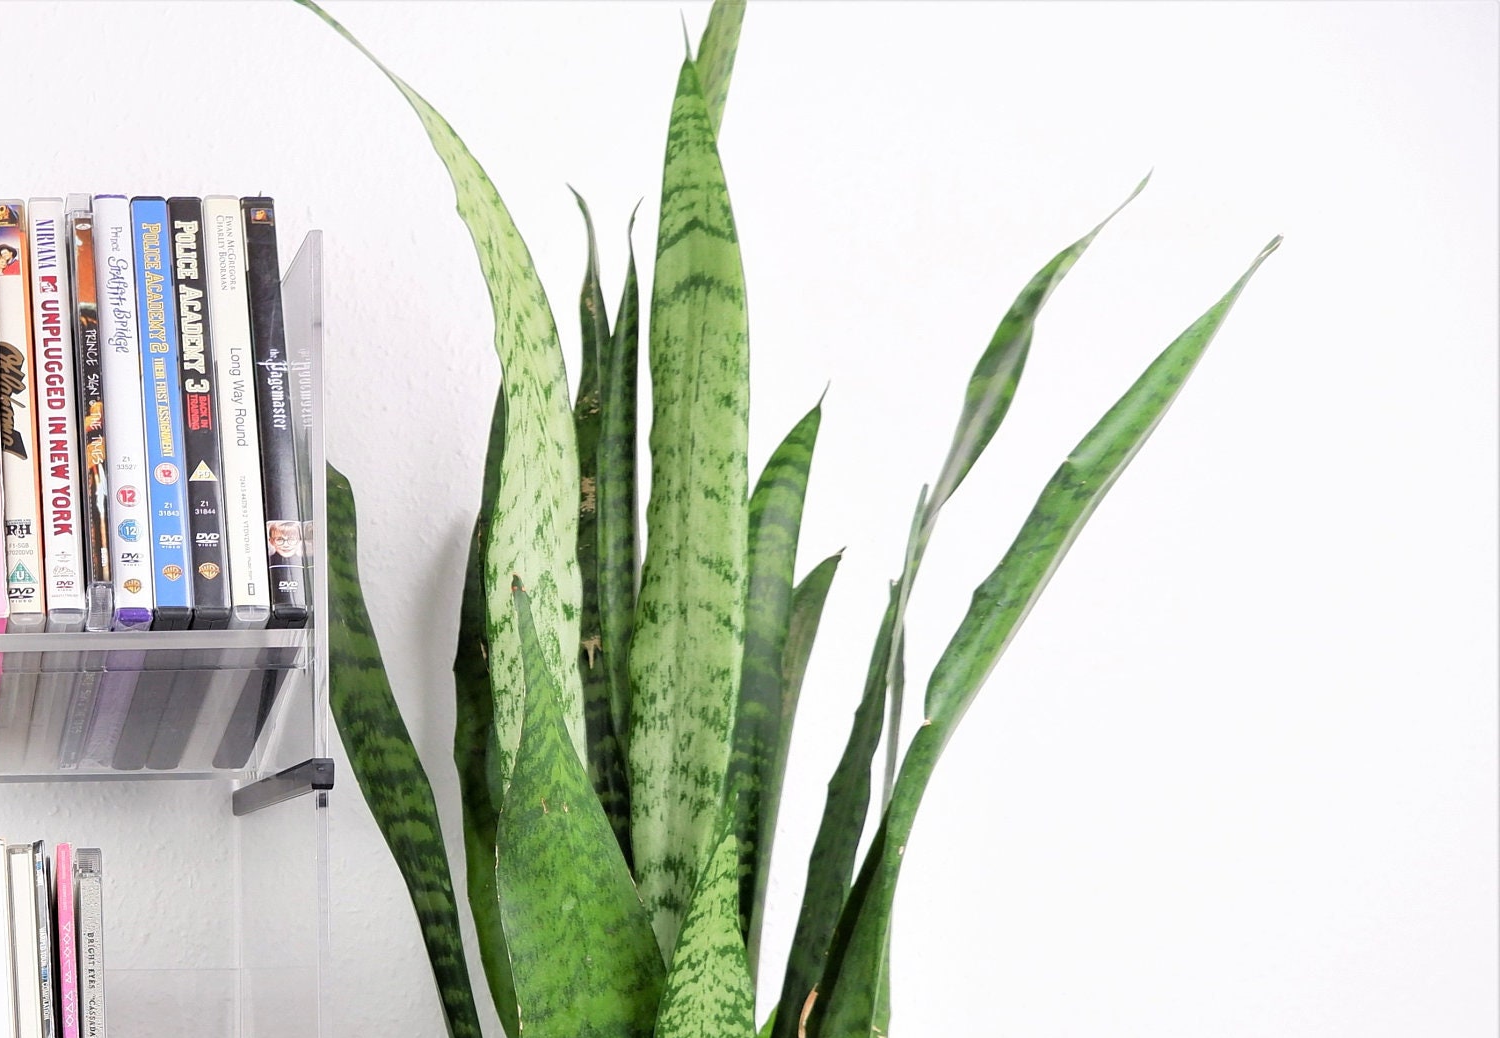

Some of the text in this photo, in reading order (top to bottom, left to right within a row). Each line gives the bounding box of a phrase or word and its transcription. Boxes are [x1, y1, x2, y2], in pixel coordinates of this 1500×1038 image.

[141, 222, 170, 354] POLICE ACADEMY 2
[216, 215, 228, 290] CHARLEY BOORMAN
[174, 220, 210, 393] POLICE ACADEMY 3
[36, 220, 73, 536] NIRVANA UNPLUGGED IN NEW YORK
[85, 329, 104, 465] PRINCE SIGN THE TIMES
[190, 394, 200, 430] TRAINING
[200, 396, 210, 428] BACK IN
[229, 348, 248, 447] Long Way Round
[120, 490, 136, 502] 12
[87, 932, 96, 966] BRIGHT
[88, 968, 96, 989] EYES
